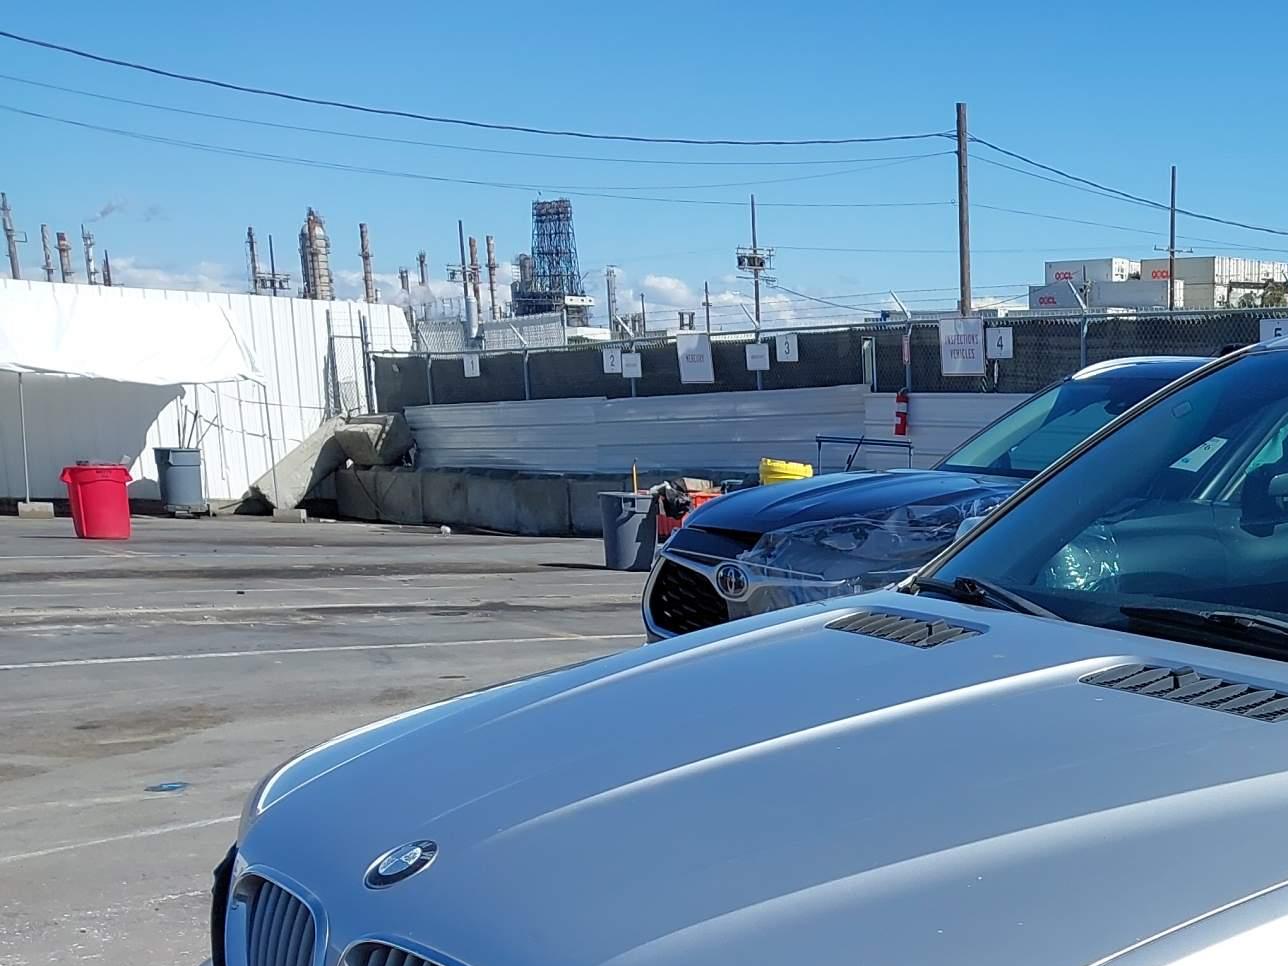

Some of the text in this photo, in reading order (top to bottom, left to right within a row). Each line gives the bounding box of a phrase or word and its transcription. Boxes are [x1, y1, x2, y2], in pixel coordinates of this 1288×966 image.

[784, 341, 790, 355] 3
[997, 335, 1004, 351] 4
[609, 354, 615, 367] 2
